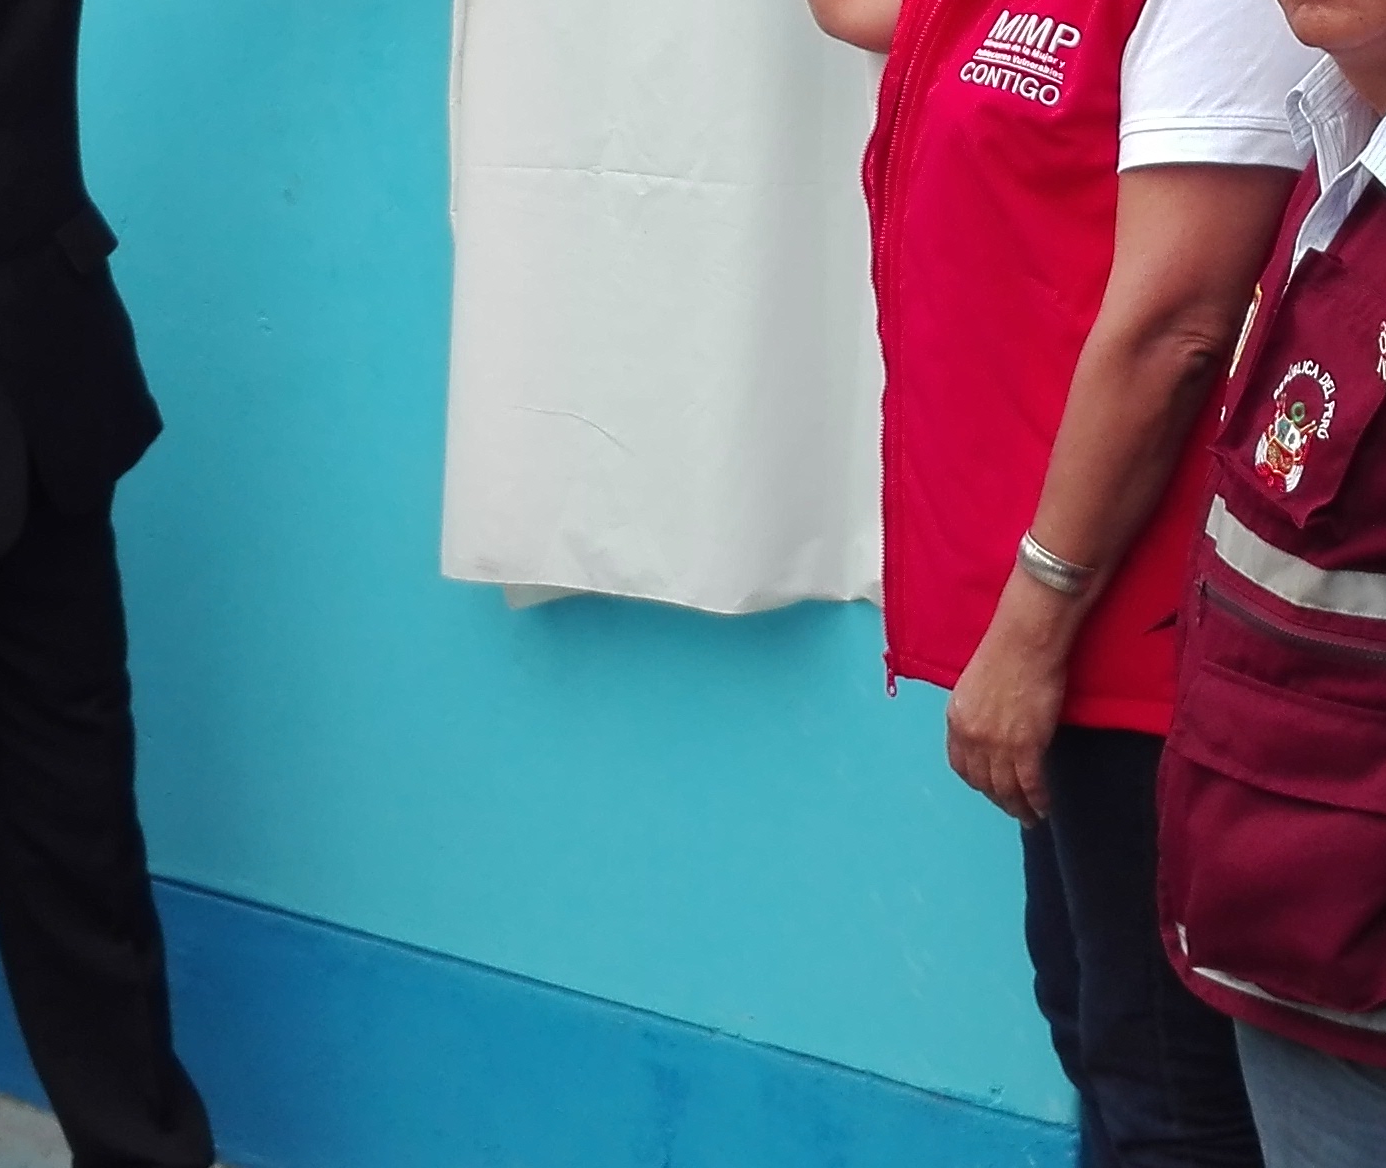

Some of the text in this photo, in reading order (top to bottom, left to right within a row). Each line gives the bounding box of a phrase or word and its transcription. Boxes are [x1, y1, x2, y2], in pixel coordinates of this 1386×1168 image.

[987, 9, 1082, 54] MIMP
[959, 61, 1061, 107] CONTIGO
[1318, 372, 1336, 400] DEL
